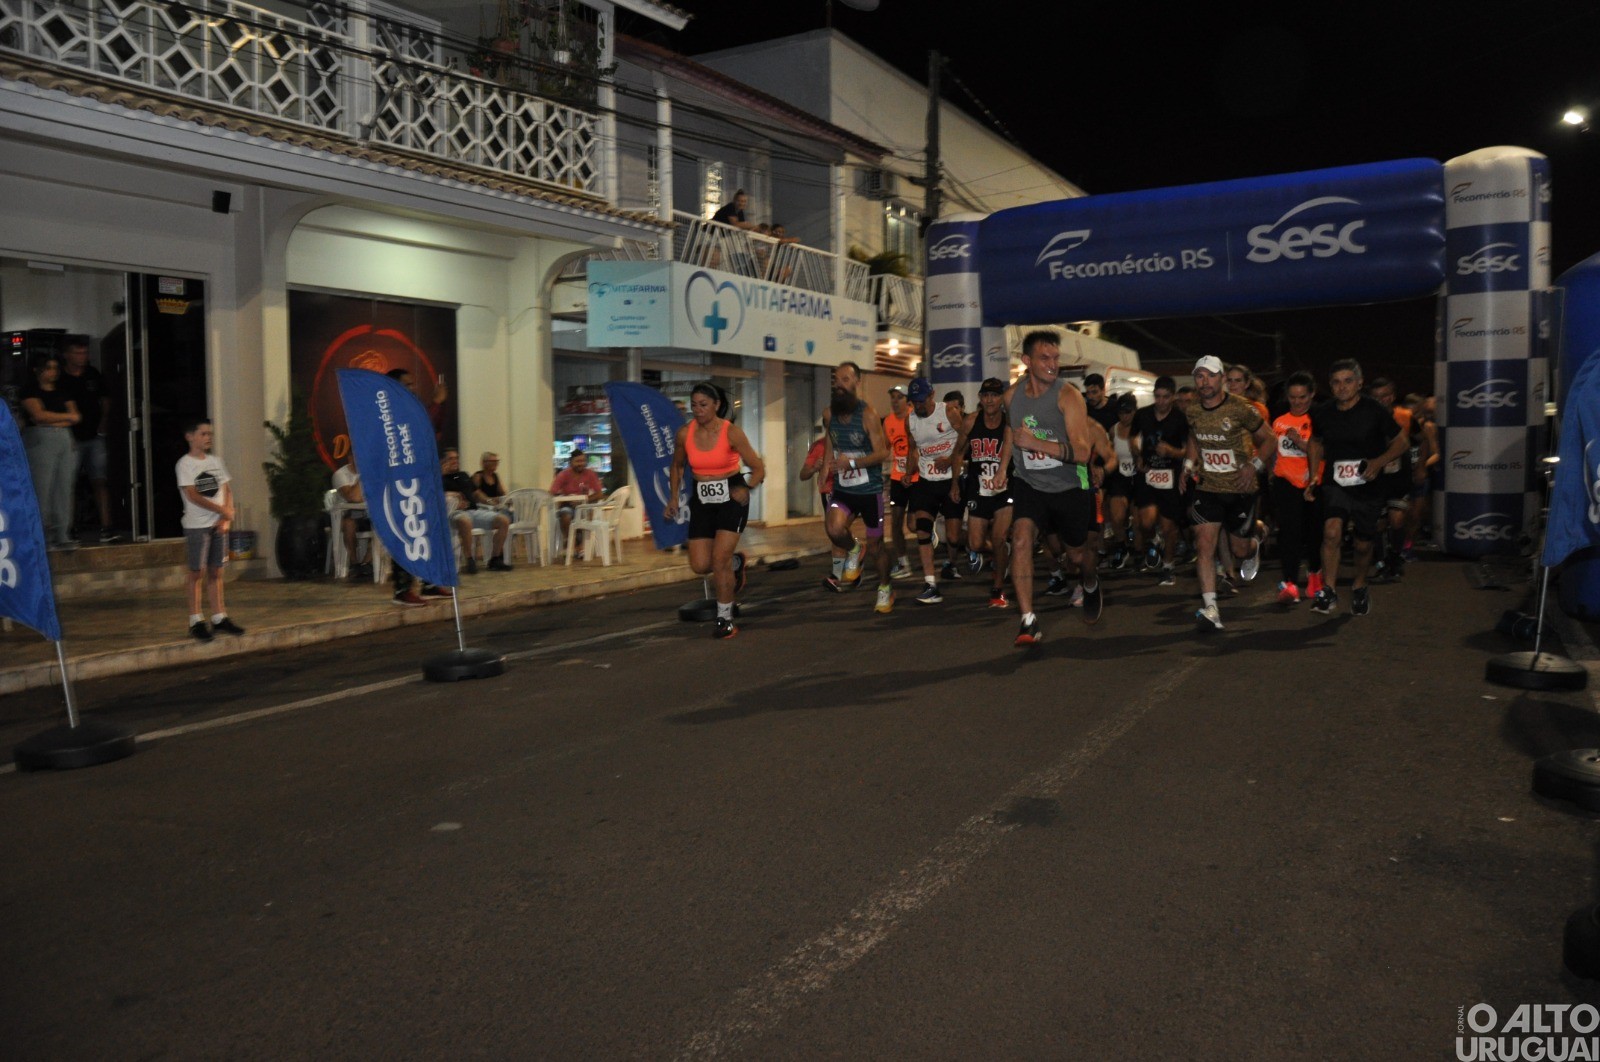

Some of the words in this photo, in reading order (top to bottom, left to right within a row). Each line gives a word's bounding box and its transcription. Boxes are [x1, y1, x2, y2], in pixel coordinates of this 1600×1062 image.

[1049, 253, 1175, 280] Fecomércio
[1181, 248, 1215, 269] RS
[611, 284, 666, 293] VITAFARMA
[741, 282, 833, 320] VITAFARMA
[375, 390, 399, 467] Fecomércio
[397, 423, 416, 465] Senac
[1196, 433, 1226, 441] MASSA
[1204, 452, 1231, 466] 300
[1149, 472, 1169, 484] 268
[700, 482, 725, 498] 863
